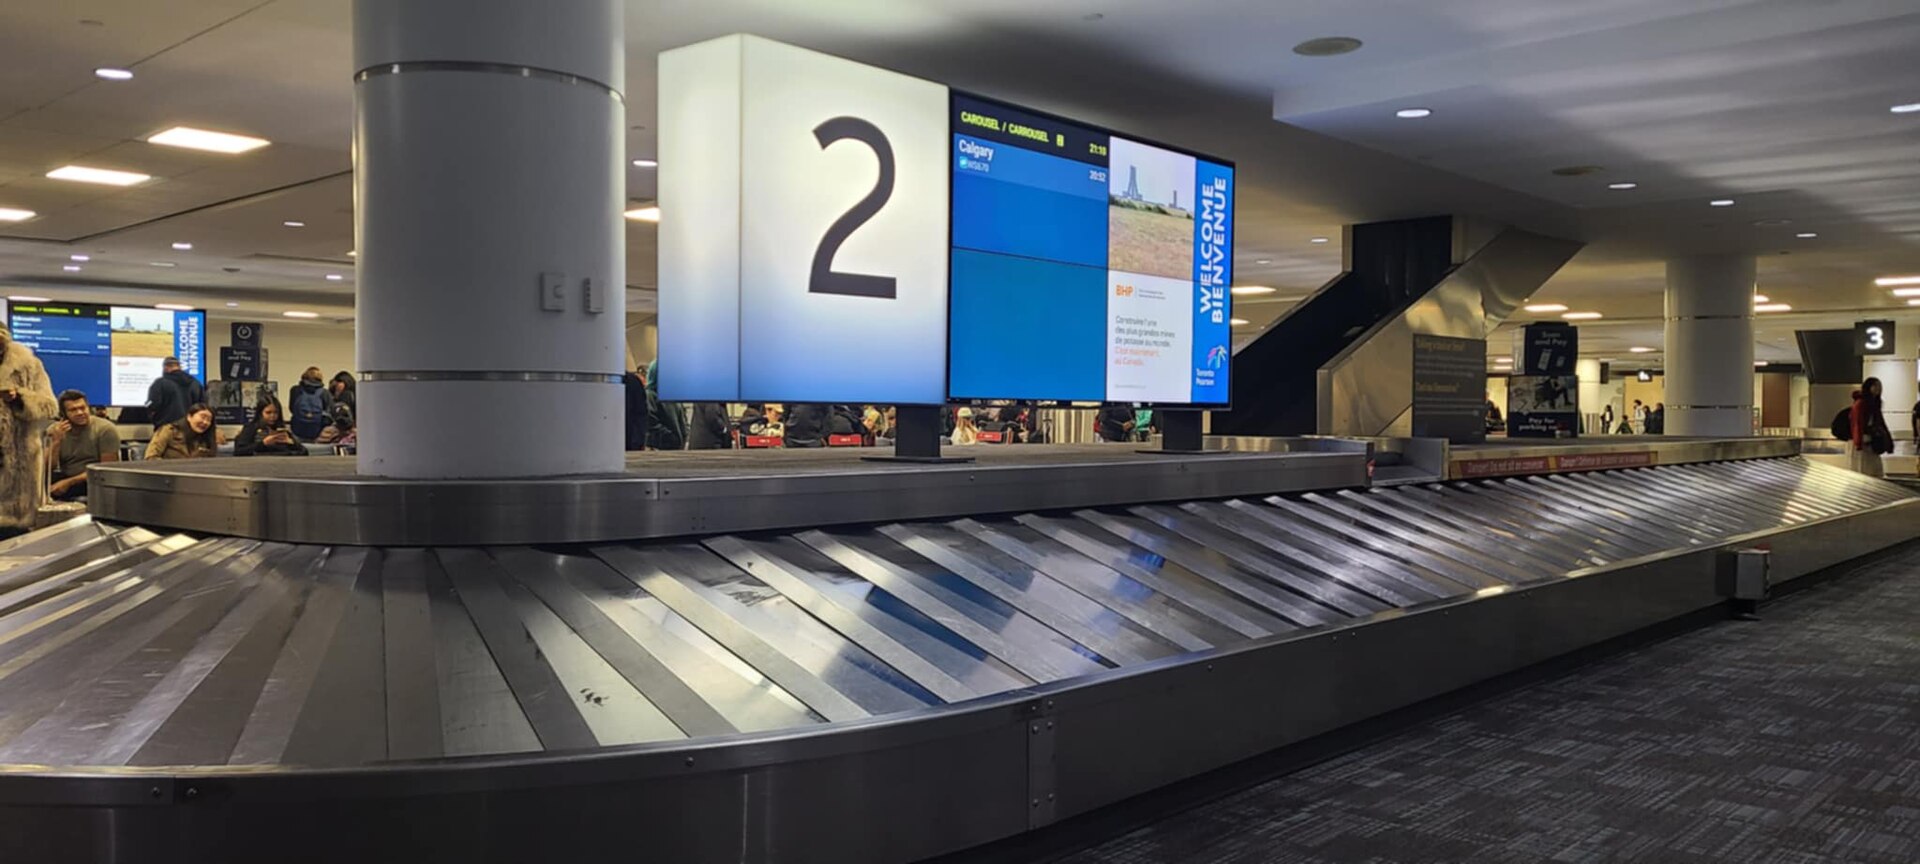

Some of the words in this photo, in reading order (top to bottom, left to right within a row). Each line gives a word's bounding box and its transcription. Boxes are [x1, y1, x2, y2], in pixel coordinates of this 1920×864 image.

[960, 111, 1000, 131] CAROUSEL
[1008, 123, 1049, 142] CARROUSEL
[959, 139, 994, 161] Calgary
[808, 116, 897, 300] 2
[1200, 183, 1214, 313] WELCOME
[1212, 177, 1226, 323] BIENVENUE
[1116, 284, 1133, 297] BHP
[1115, 326, 1125, 334] des
[1138, 328, 1159, 338] grandes
[1865, 327, 1884, 350] 3
[179, 319, 188, 371] WELCOME
[188, 316, 199, 375] BIENVENUE
[1195, 377, 1215, 386] Pearson
[1196, 368, 1215, 377] Toronto
[1518, 424, 1547, 432] parking
